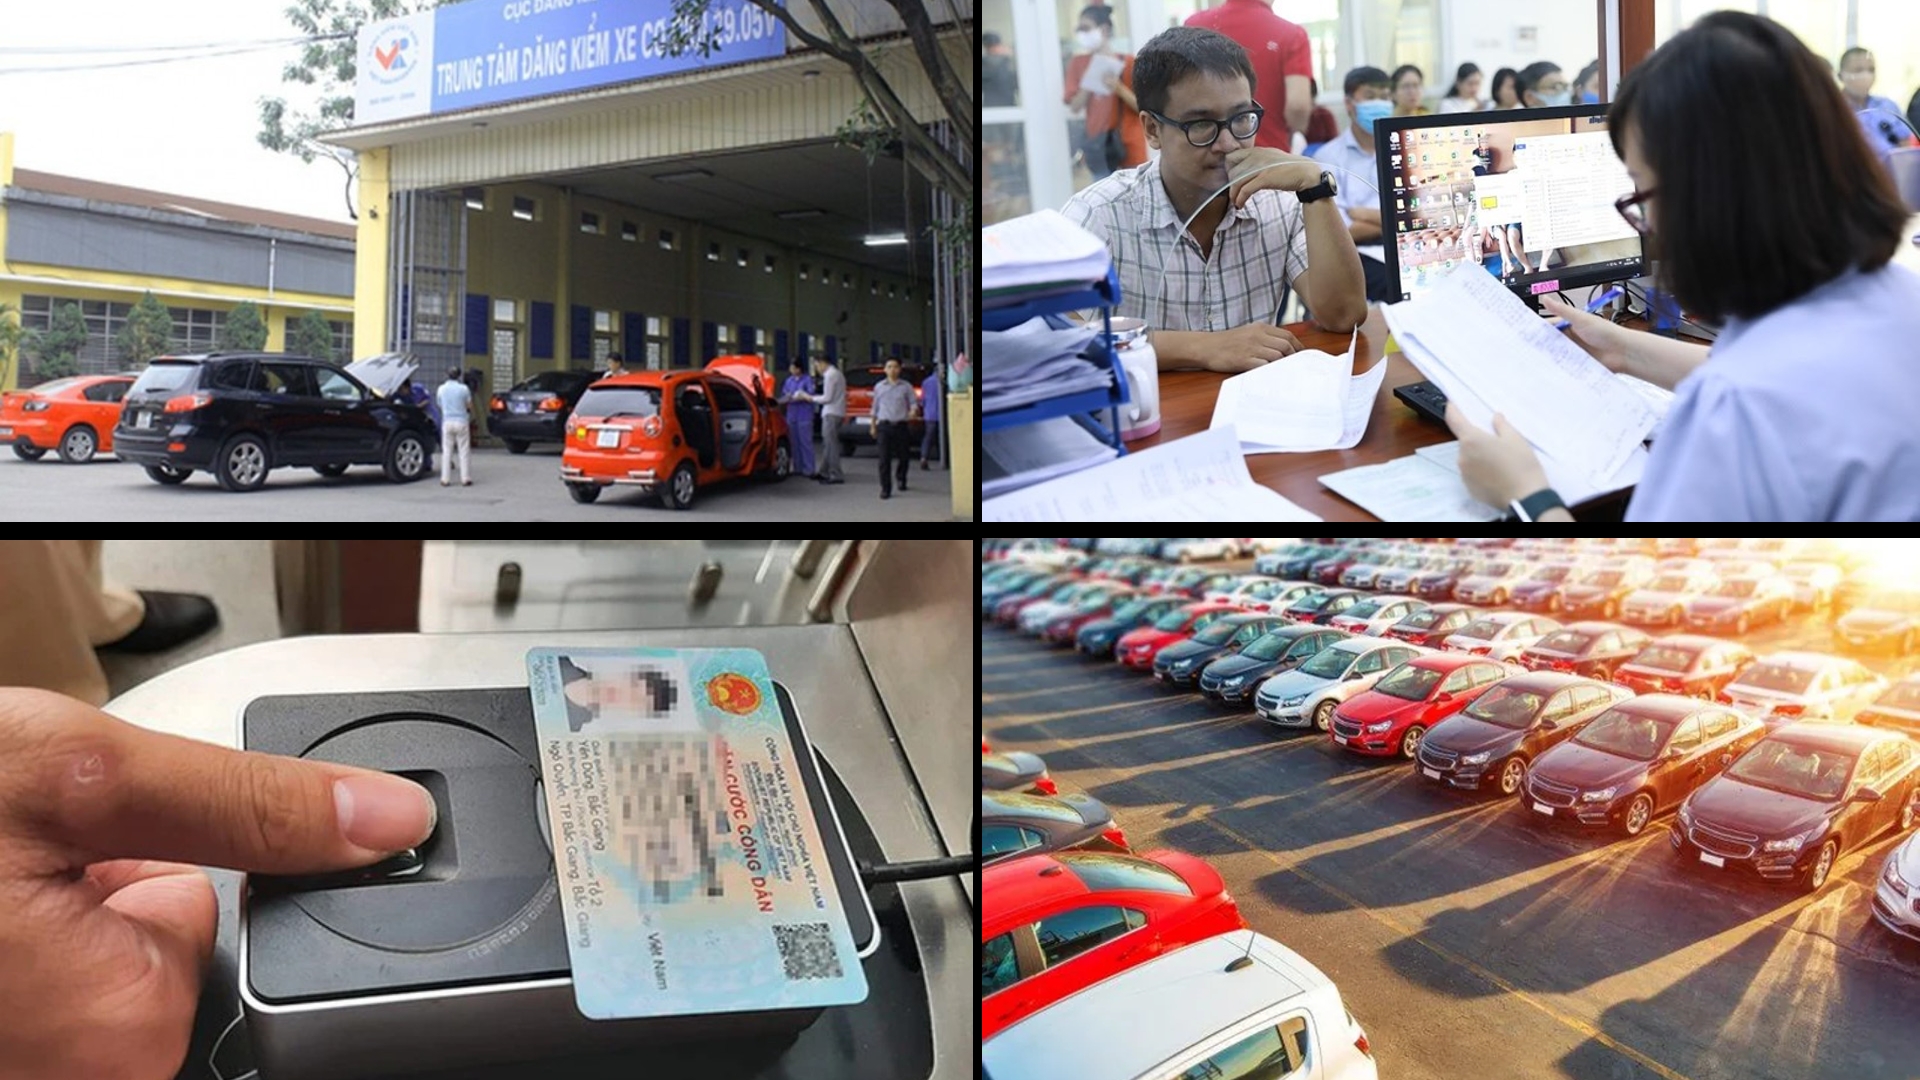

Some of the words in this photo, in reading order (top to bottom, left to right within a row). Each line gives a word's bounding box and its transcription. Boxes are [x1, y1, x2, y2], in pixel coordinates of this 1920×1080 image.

[437, 59, 482, 96] TRUNG
[487, 43, 518, 86] TÂM
[522, 34, 566, 80] ĐĂNG
[571, 12, 610, 72] KIỂM
[614, 25, 637, 64] XE
[591, 818, 606, 851] Giang
[738, 823, 762, 872] CÔNG
[752, 877, 774, 912] DÂN
[811, 887, 825, 909] NAM
[576, 911, 591, 948] Giang
[653, 959, 667, 990] Nam
